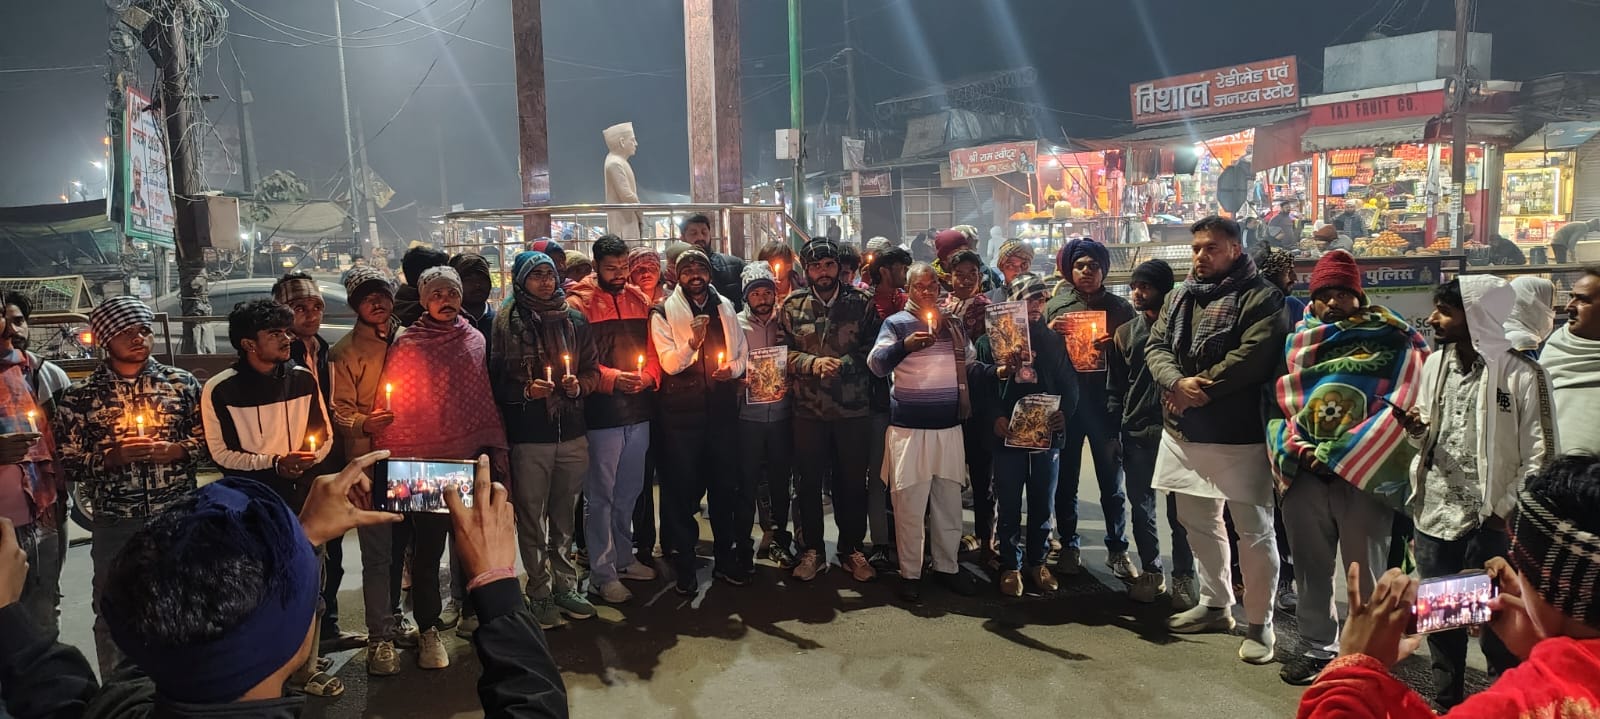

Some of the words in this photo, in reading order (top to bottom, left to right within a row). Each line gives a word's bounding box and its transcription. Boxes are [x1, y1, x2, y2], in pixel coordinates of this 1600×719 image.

[1215, 67, 1264, 88] रेडीमेड
[1266, 62, 1289, 80] एवं
[1134, 80, 1211, 115] विशाल
[1214, 87, 1260, 107] जनरल
[1262, 81, 1295, 101] स्टोर
[1330, 104, 1349, 120] TAJ
[1356, 100, 1389, 116] FRUIT
[1397, 97, 1418, 112] CO.
[1365, 267, 1415, 285] पुलिस
